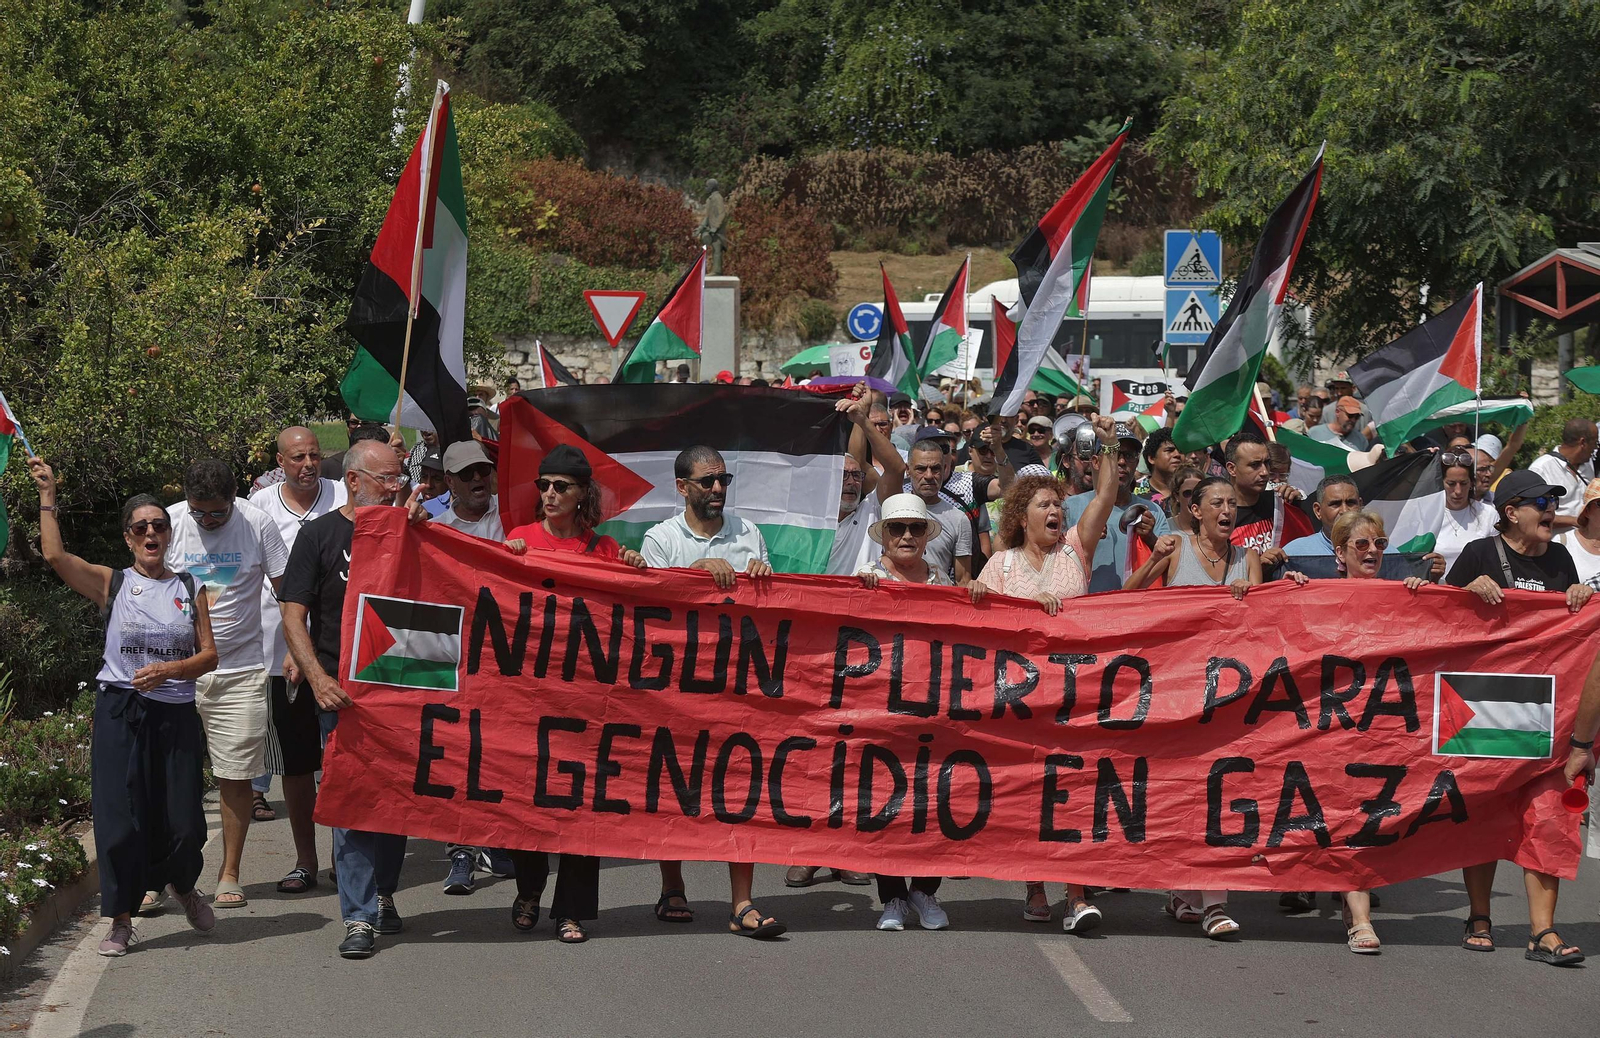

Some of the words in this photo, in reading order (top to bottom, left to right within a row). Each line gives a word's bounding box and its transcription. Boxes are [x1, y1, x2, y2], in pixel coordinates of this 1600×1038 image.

[1129, 383, 1159, 395] Free
[184, 552, 242, 563] MCKENZIE
[120, 646, 145, 655] FREE
[828, 625, 1153, 731] PUERTO
[1197, 654, 1421, 733] PARA
[413, 703, 504, 804] EL
[533, 724, 993, 841] GENOCIDIO
[1038, 753, 1149, 844] EN
[1205, 756, 1469, 849] GAZA
